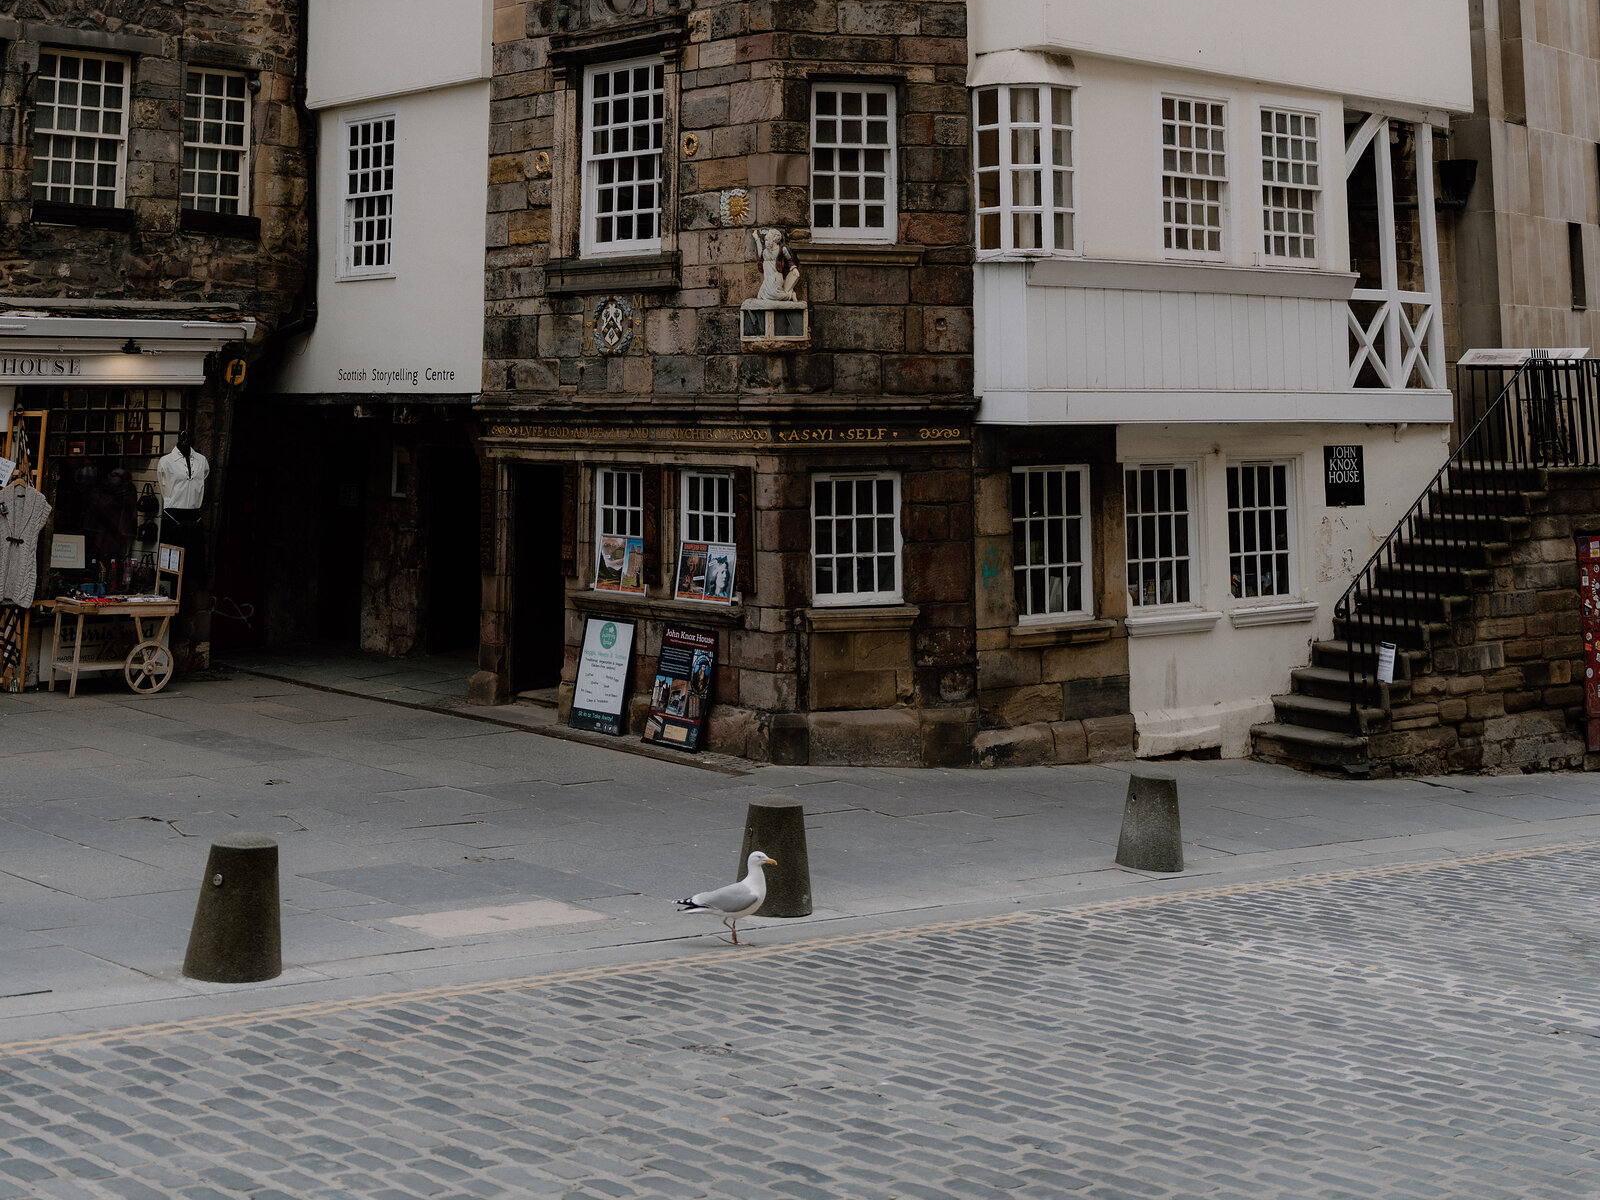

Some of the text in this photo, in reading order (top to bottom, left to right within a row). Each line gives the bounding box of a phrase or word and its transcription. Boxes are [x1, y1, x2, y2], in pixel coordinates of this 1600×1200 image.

[632, 294, 644, 309] M
[2, 358, 81, 376] HOUSE
[338, 367, 455, 386] Scottish Storytelling Centre
[549, 426, 569, 438] GOD
[788, 429, 810, 441] AS
[845, 428, 887, 441] SELF
[1332, 446, 1356, 458] JOHN
[1329, 458, 1358, 471] KNOX
[1328, 470, 1360, 484] HOUSE
[665, 628, 680, 639] John
[680, 631, 696, 641] Knox
[696, 633, 715, 645] House
